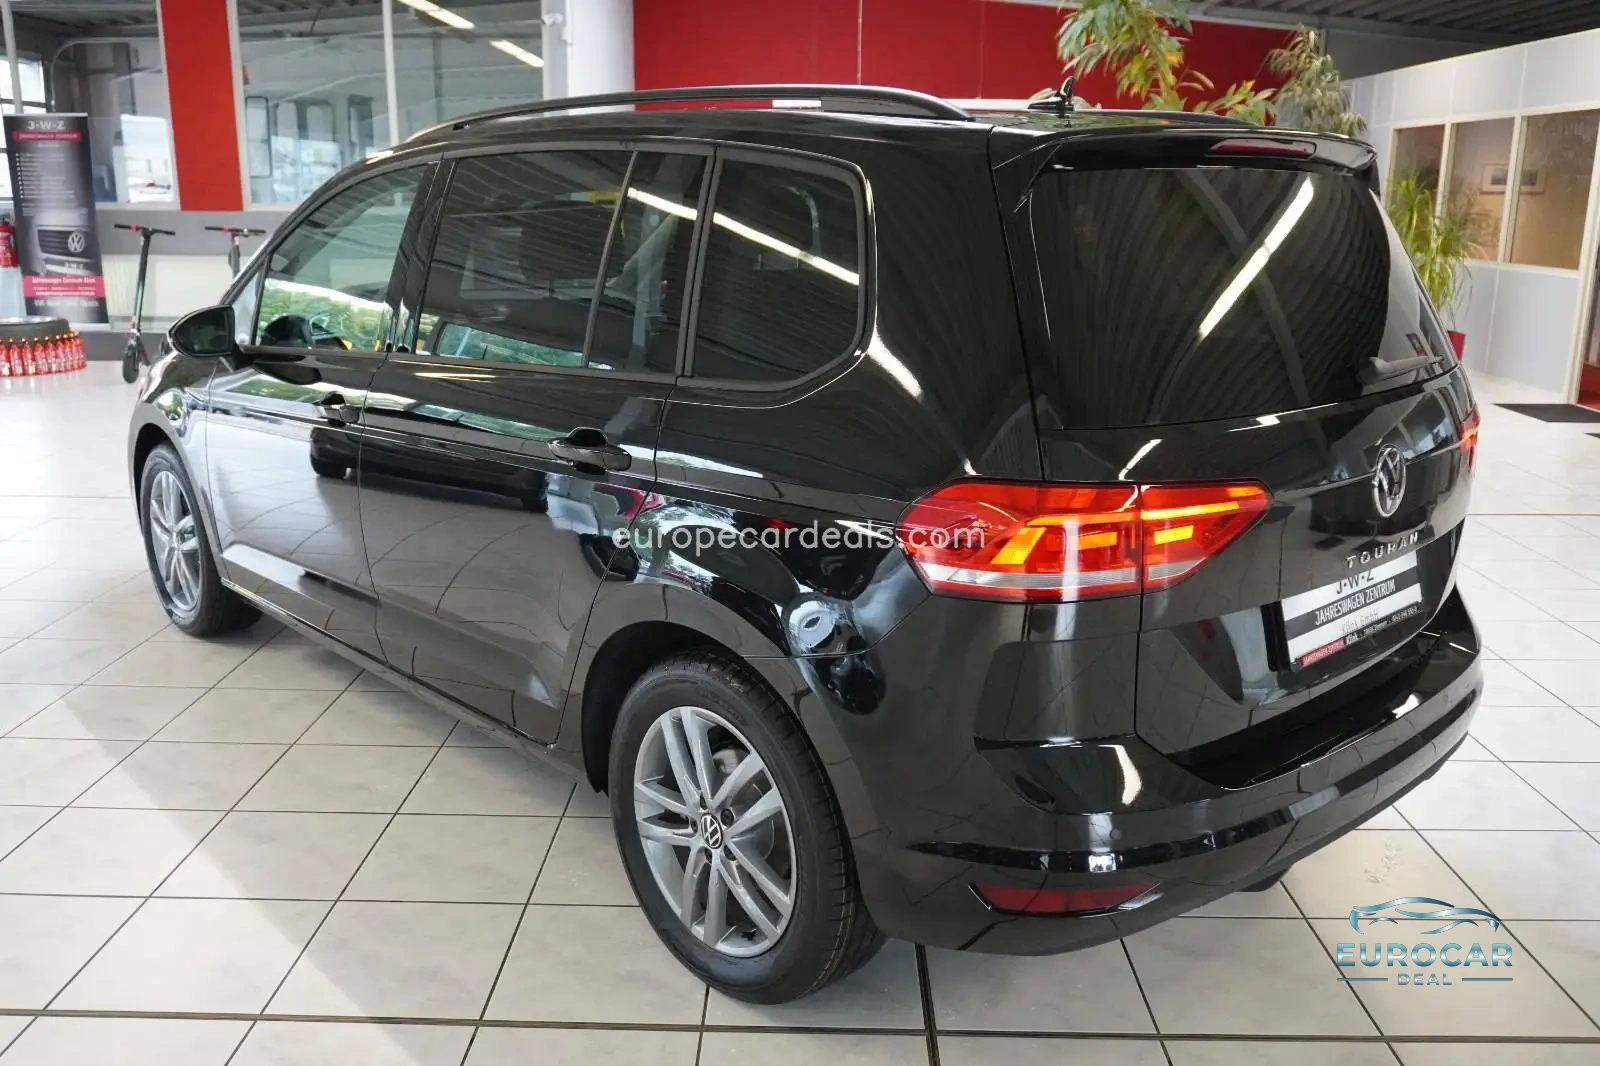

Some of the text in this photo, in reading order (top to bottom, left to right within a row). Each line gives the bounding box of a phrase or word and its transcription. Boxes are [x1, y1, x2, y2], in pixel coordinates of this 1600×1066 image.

[1345, 531, 1419, 569] TOURAN
[1314, 594, 1366, 626] JAHRESWAGEN
[1365, 578, 1397, 602] ZENTRUM
